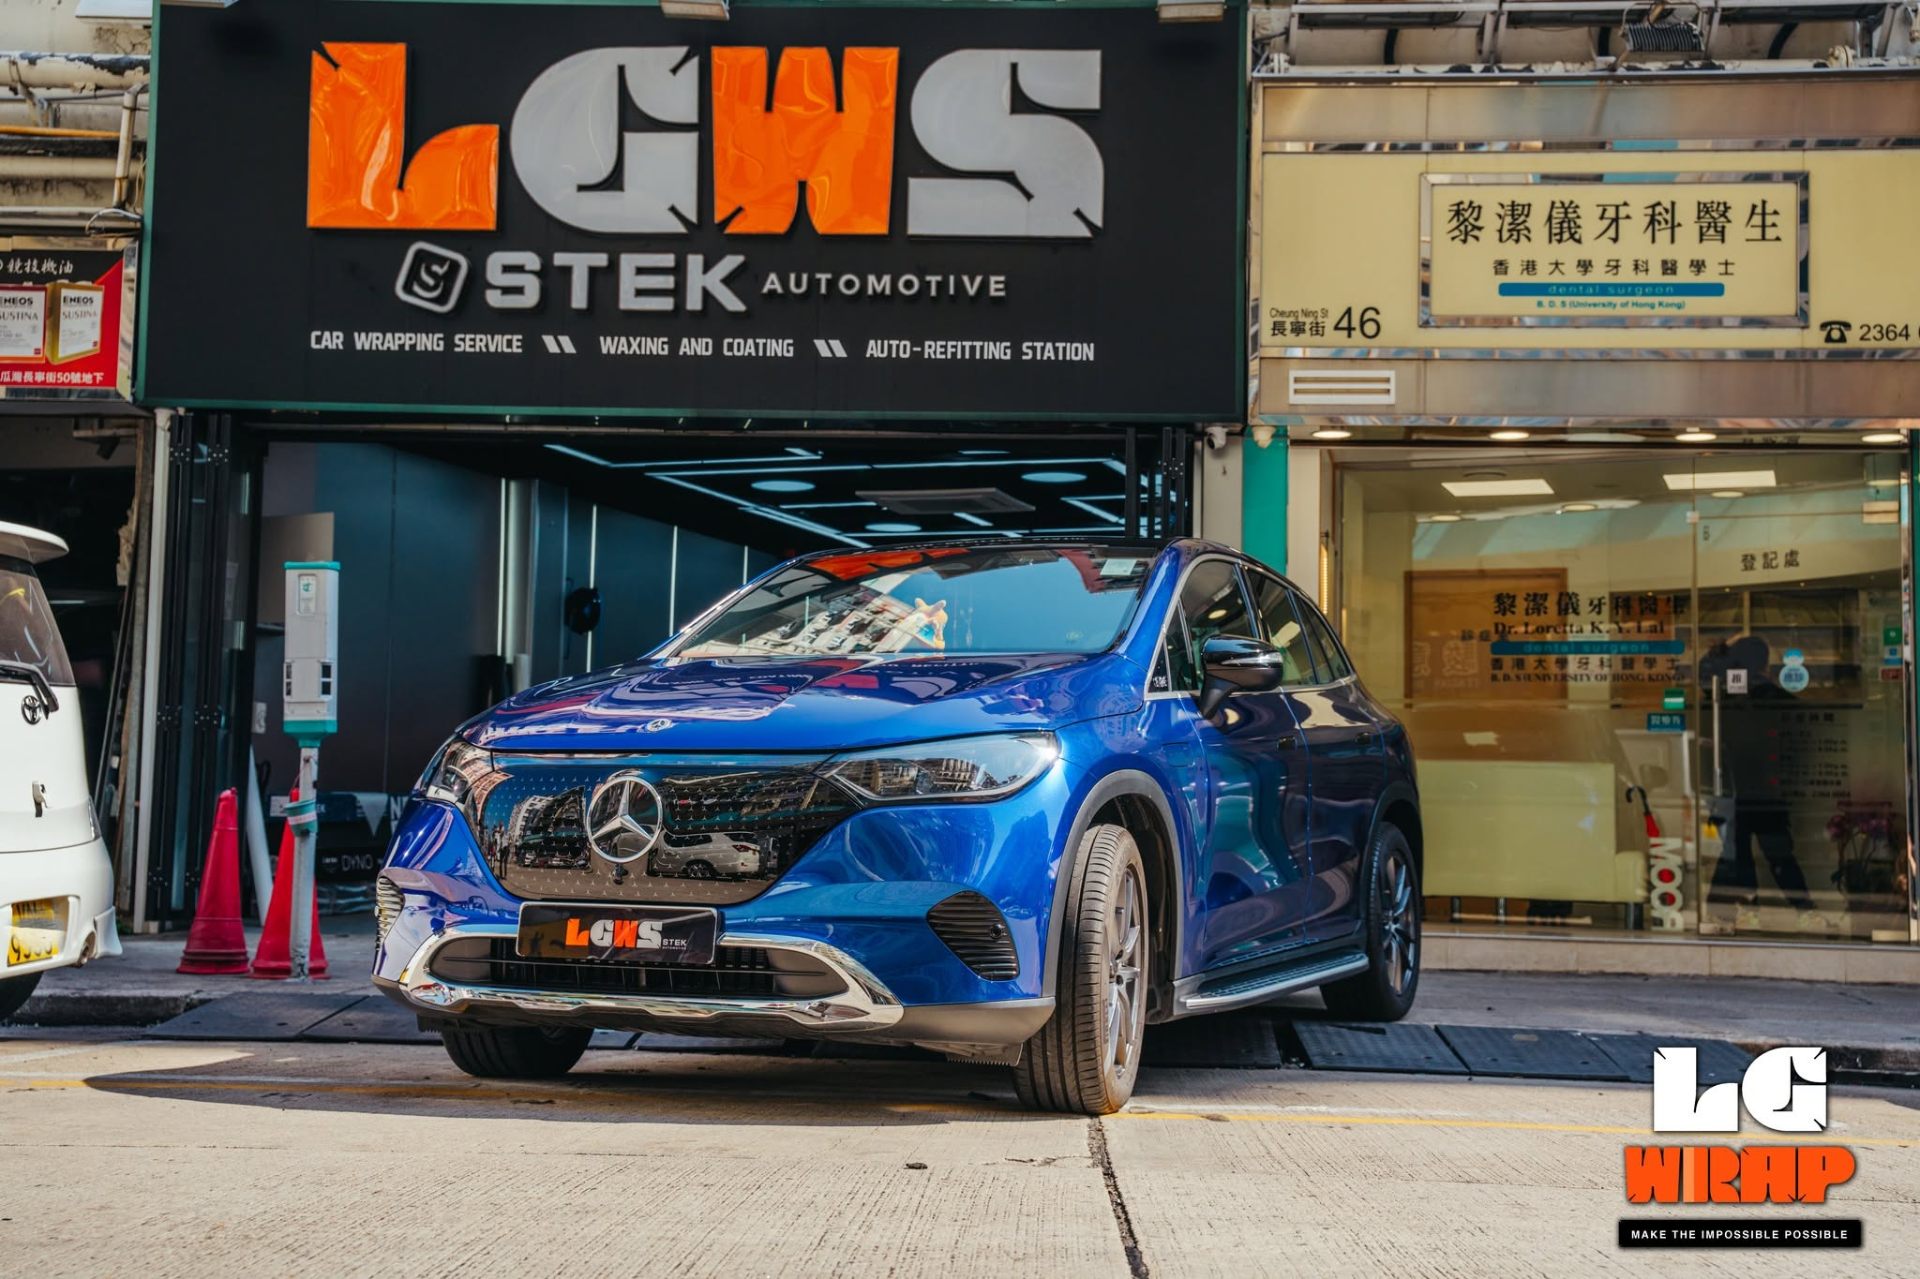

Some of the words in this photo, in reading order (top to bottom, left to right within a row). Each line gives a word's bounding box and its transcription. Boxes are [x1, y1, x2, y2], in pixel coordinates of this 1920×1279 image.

[306, 41, 1105, 239] LGWS
[1446, 199, 1784, 245] 黎潔儀牙科醫生
[1492, 258, 1736, 276] 香港大學牙科醫學士
[485, 251, 748, 313] STEK
[761, 272, 1007, 297] AUTOMOTIVE
[1548, 283, 1600, 295] dental
[1607, 285, 1675, 296] surgeon
[62, 295, 94, 305] ENEOS
[1569, 300, 1617, 310] (University
[1620, 300, 1629, 308] of
[1632, 300, 1656, 310] Hong
[1658, 300, 1686, 310] Kong)
[0, 311, 38, 321] USTINA
[1269, 307, 1299, 319] Cheung
[1301, 307, 1319, 319] Ning
[1320, 307, 1329, 319] St
[1333, 306, 1382, 339] 46
[310, 330, 344, 351] CAR
[354, 331, 444, 352] WRAPPING
[454, 333, 523, 353] SERVICE
[1858, 323, 1910, 342] 2364
[600, 336, 669, 356] WAXING
[679, 337, 713, 356] AND
[723, 337, 794, 357] COATING
[866, 339, 1012, 360] AUTO-REFITTING
[1022, 341, 1095, 361] STATION
[1740, 549, 1800, 572] 登記處
[1493, 591, 1687, 616] 黎潔儀牙科醫生
[1493, 621, 1519, 635] Dr.
[1523, 621, 1584, 635] Loretta
[1590, 621, 1611, 634] K.
[1524, 642, 1574, 654] dental
[1583, 643, 1650, 656] surgeon
[341, 854, 374, 871] DYNO
[565, 918, 663, 949] LGWS
